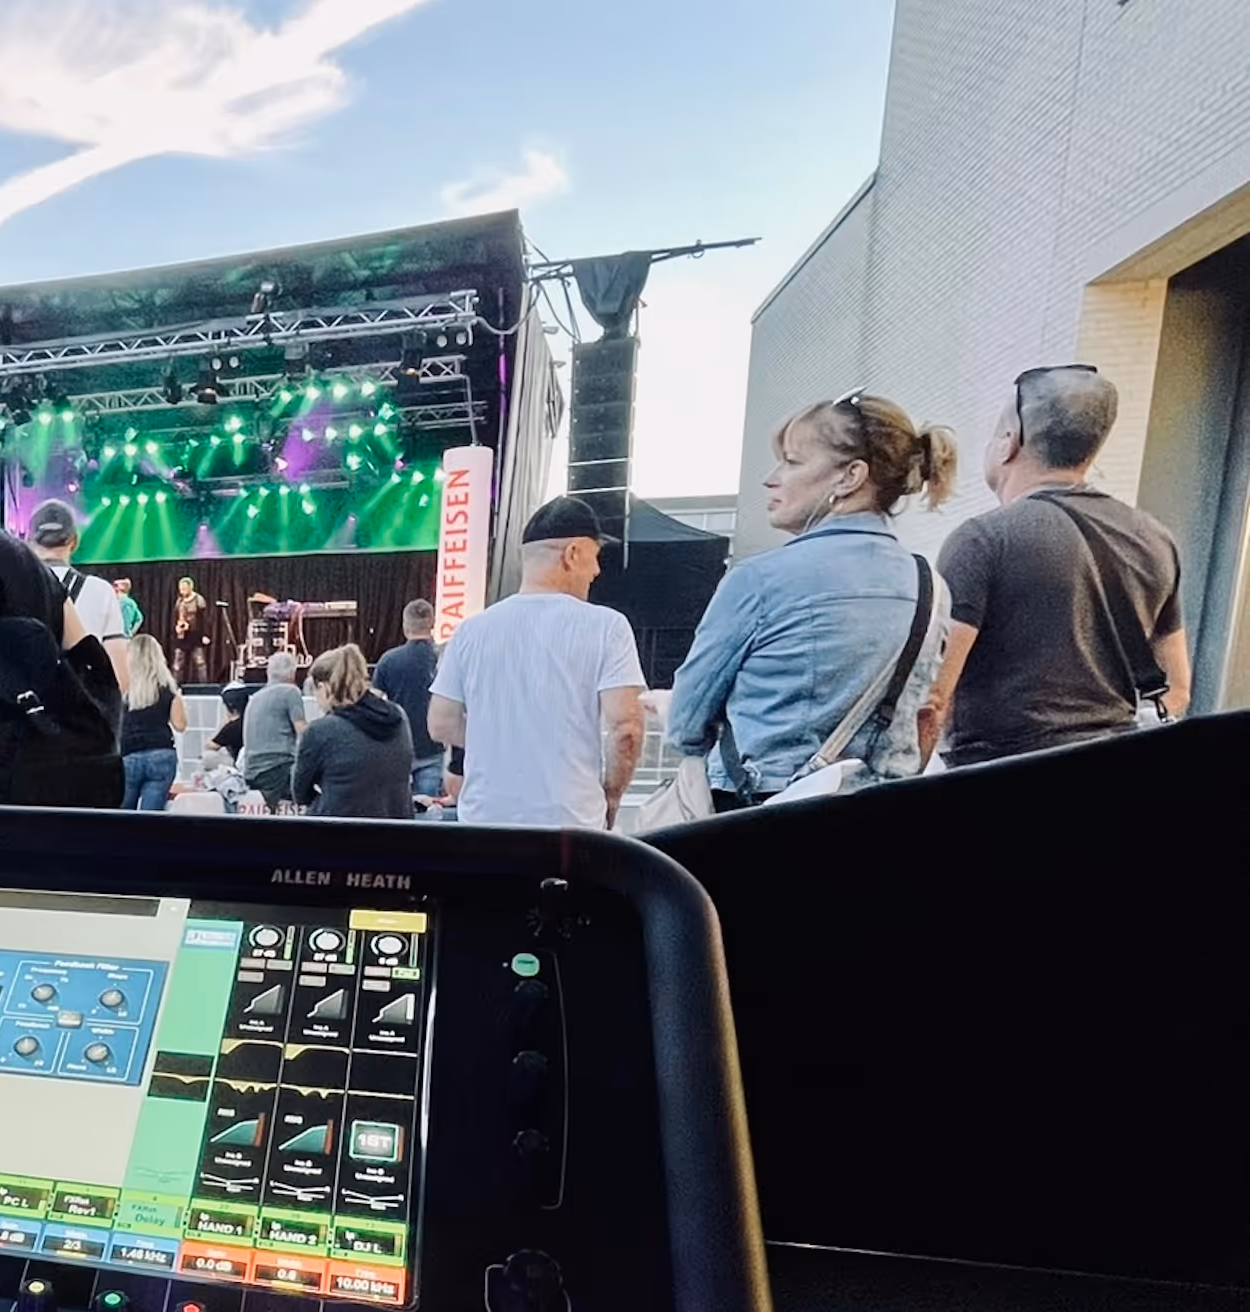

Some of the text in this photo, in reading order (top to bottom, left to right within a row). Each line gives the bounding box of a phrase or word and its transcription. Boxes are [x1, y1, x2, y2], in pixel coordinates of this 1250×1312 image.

[440, 469, 470, 639] RAIFFEISEN
[271, 868, 411, 890] ALLEN HEATH
[3, 1195, 19, 1207] PC
[134, 1213, 167, 1228] Delay
[198, 1220, 234, 1235] HAND
[62, 1238, 82, 1251] 2/3
[269, 1230, 317, 1246] HAND 2
[353, 1240, 371, 1253] DJ
[144, 1250, 167, 1264] kHz
[196, 1256, 232, 1273] 0.0 dB
[335, 1276, 395, 1295] 10.00 kHz
